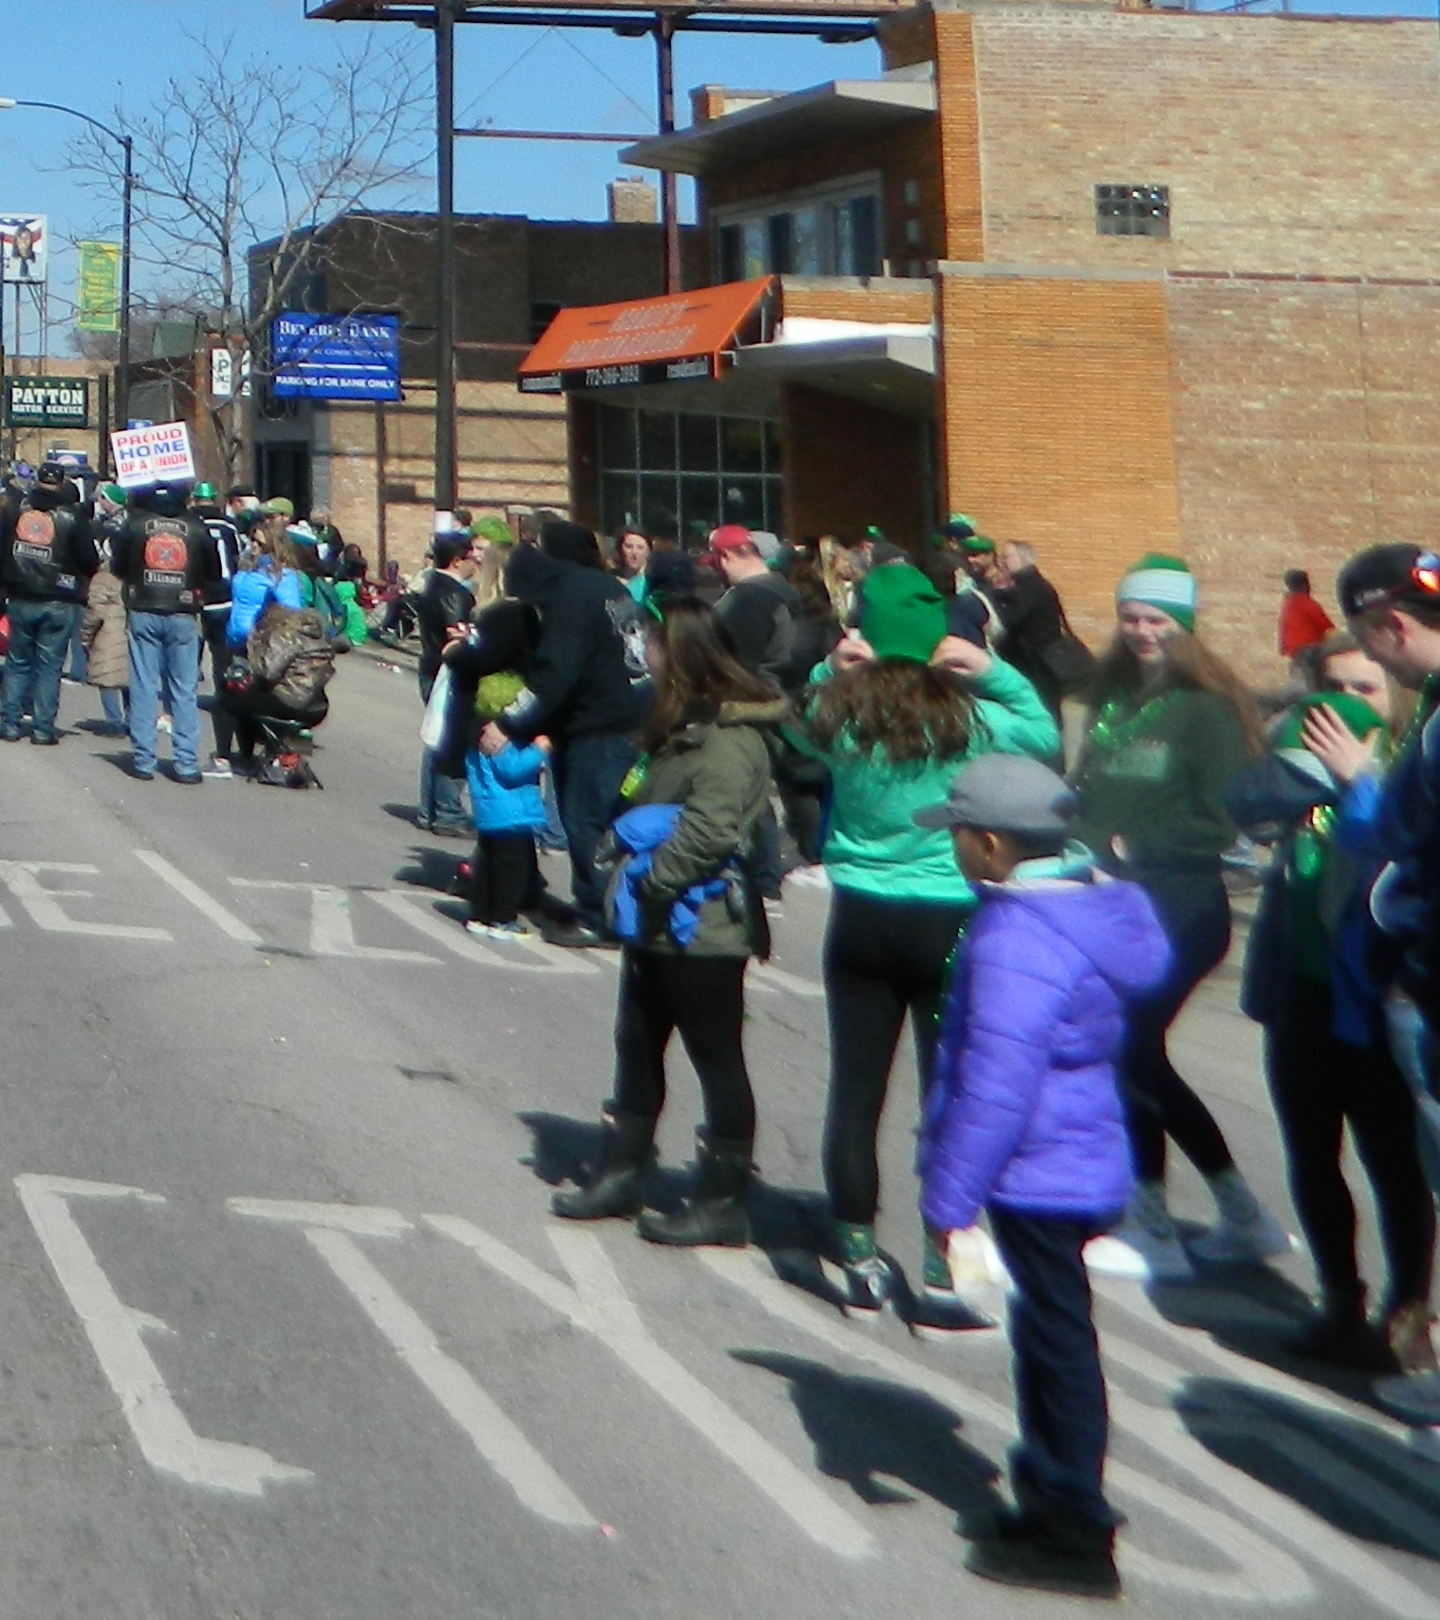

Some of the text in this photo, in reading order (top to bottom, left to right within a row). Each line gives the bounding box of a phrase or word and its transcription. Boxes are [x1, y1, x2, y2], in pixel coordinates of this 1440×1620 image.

[275, 376, 317, 386] PARKING
[340, 378, 366, 388] BANK
[367, 379, 395, 388] ONLY
[11, 387, 84, 405] PATTON
[12, 404, 84, 415] MOTOR SERVICE
[116, 428, 183, 448] PROUD
[119, 439, 185, 460] HOME
[121, 461, 136, 473] OF
[139, 460, 148, 470] A
